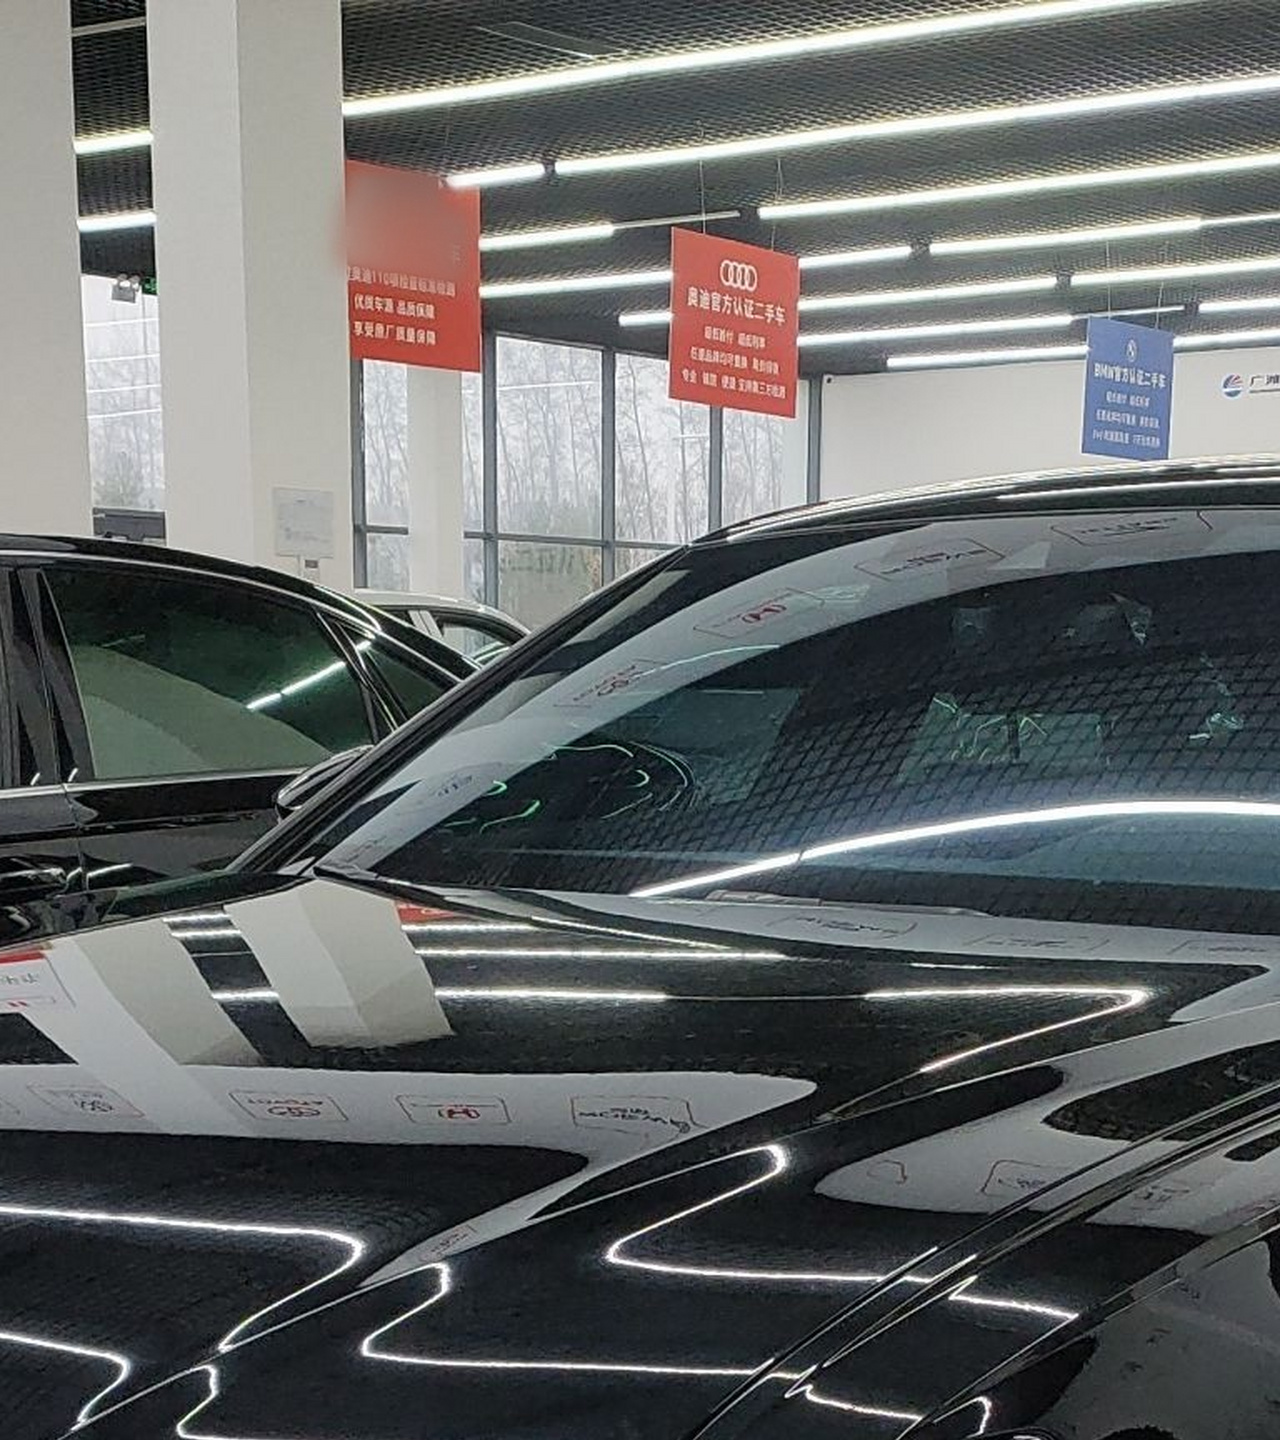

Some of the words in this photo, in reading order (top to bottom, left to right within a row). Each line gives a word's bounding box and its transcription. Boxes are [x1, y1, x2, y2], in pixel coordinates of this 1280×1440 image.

[687, 286, 786, 326] 奥迪官方认证二手车
